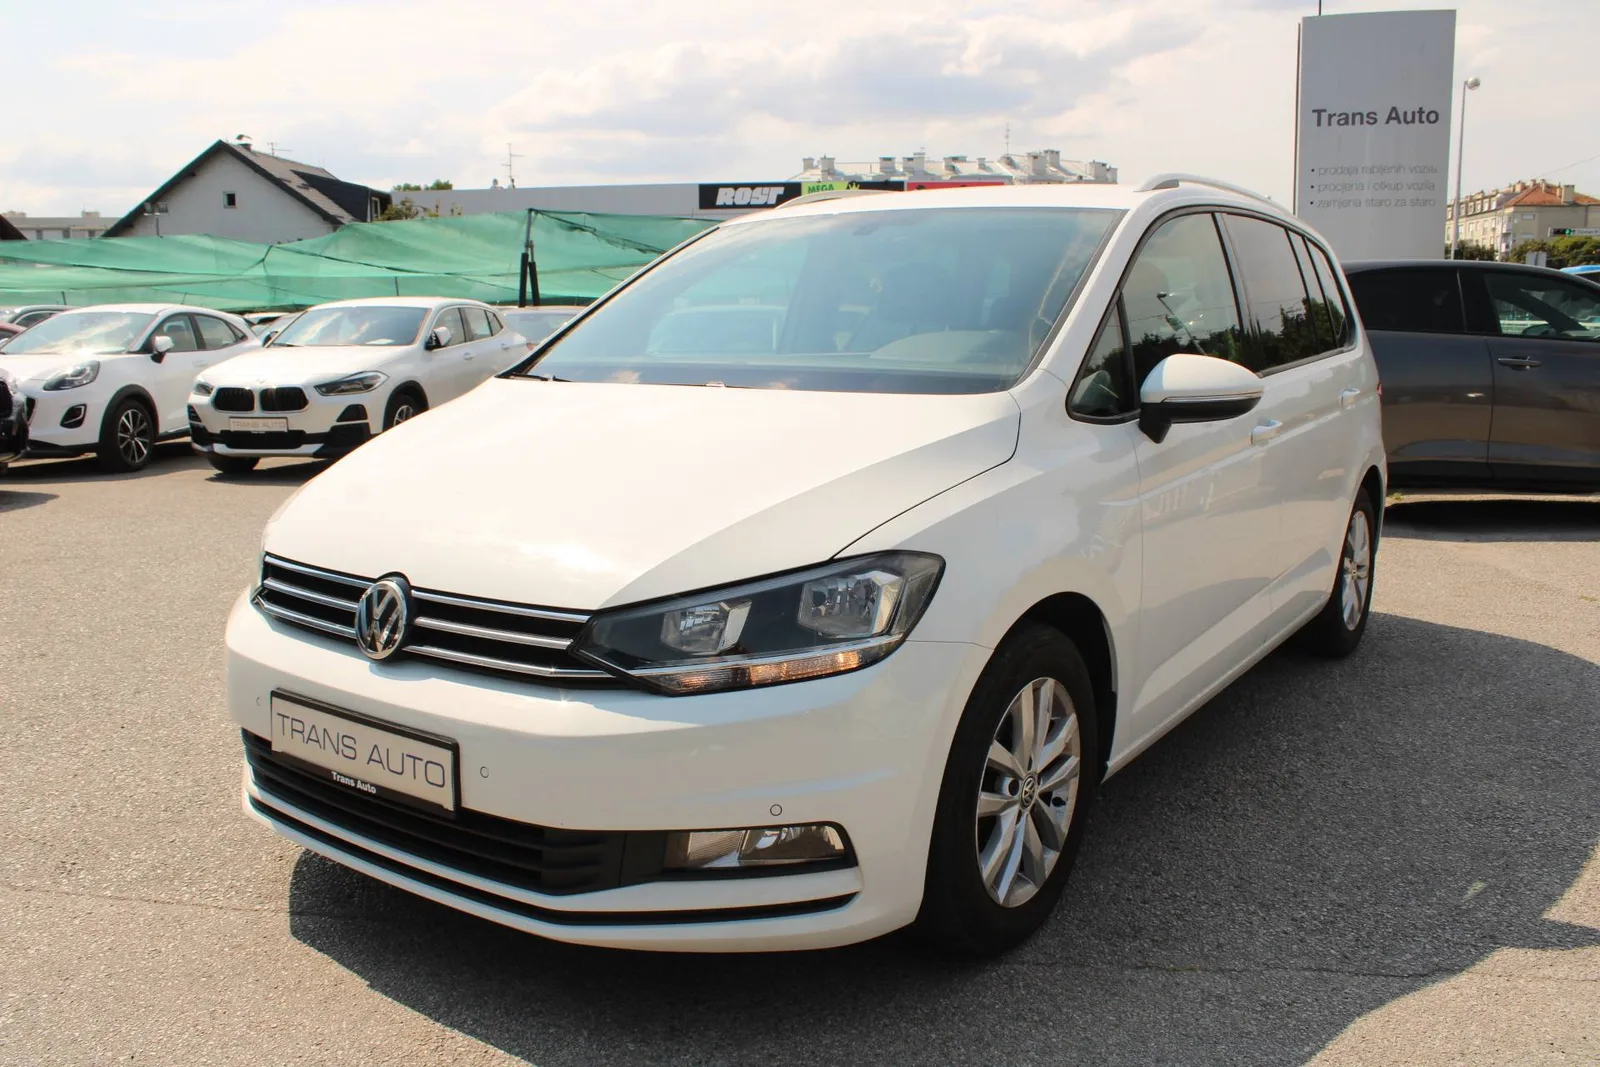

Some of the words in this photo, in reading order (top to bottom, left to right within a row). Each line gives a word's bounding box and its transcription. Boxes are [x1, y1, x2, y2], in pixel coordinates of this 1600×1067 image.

[1311, 108, 1378, 127] Trans
[1385, 106, 1440, 125] Auto
[1318, 163, 1359, 177] prodaja
[1361, 162, 1406, 176] rabljenih
[1409, 162, 1438, 174] vozila
[808, 183, 835, 194] MEGA
[1317, 181, 1365, 194] procjena
[1373, 180, 1404, 193] otkup
[1406, 179, 1435, 191] vozila
[1316, 199, 1362, 211] zamjena
[1364, 198, 1391, 208] staro
[1394, 199, 1407, 208] za
[1409, 197, 1437, 207] staro
[276, 712, 358, 761] TRANS
[366, 744, 446, 788] AUTO
[331, 771, 356, 788] Trans
[356, 779, 377, 794] Auto
